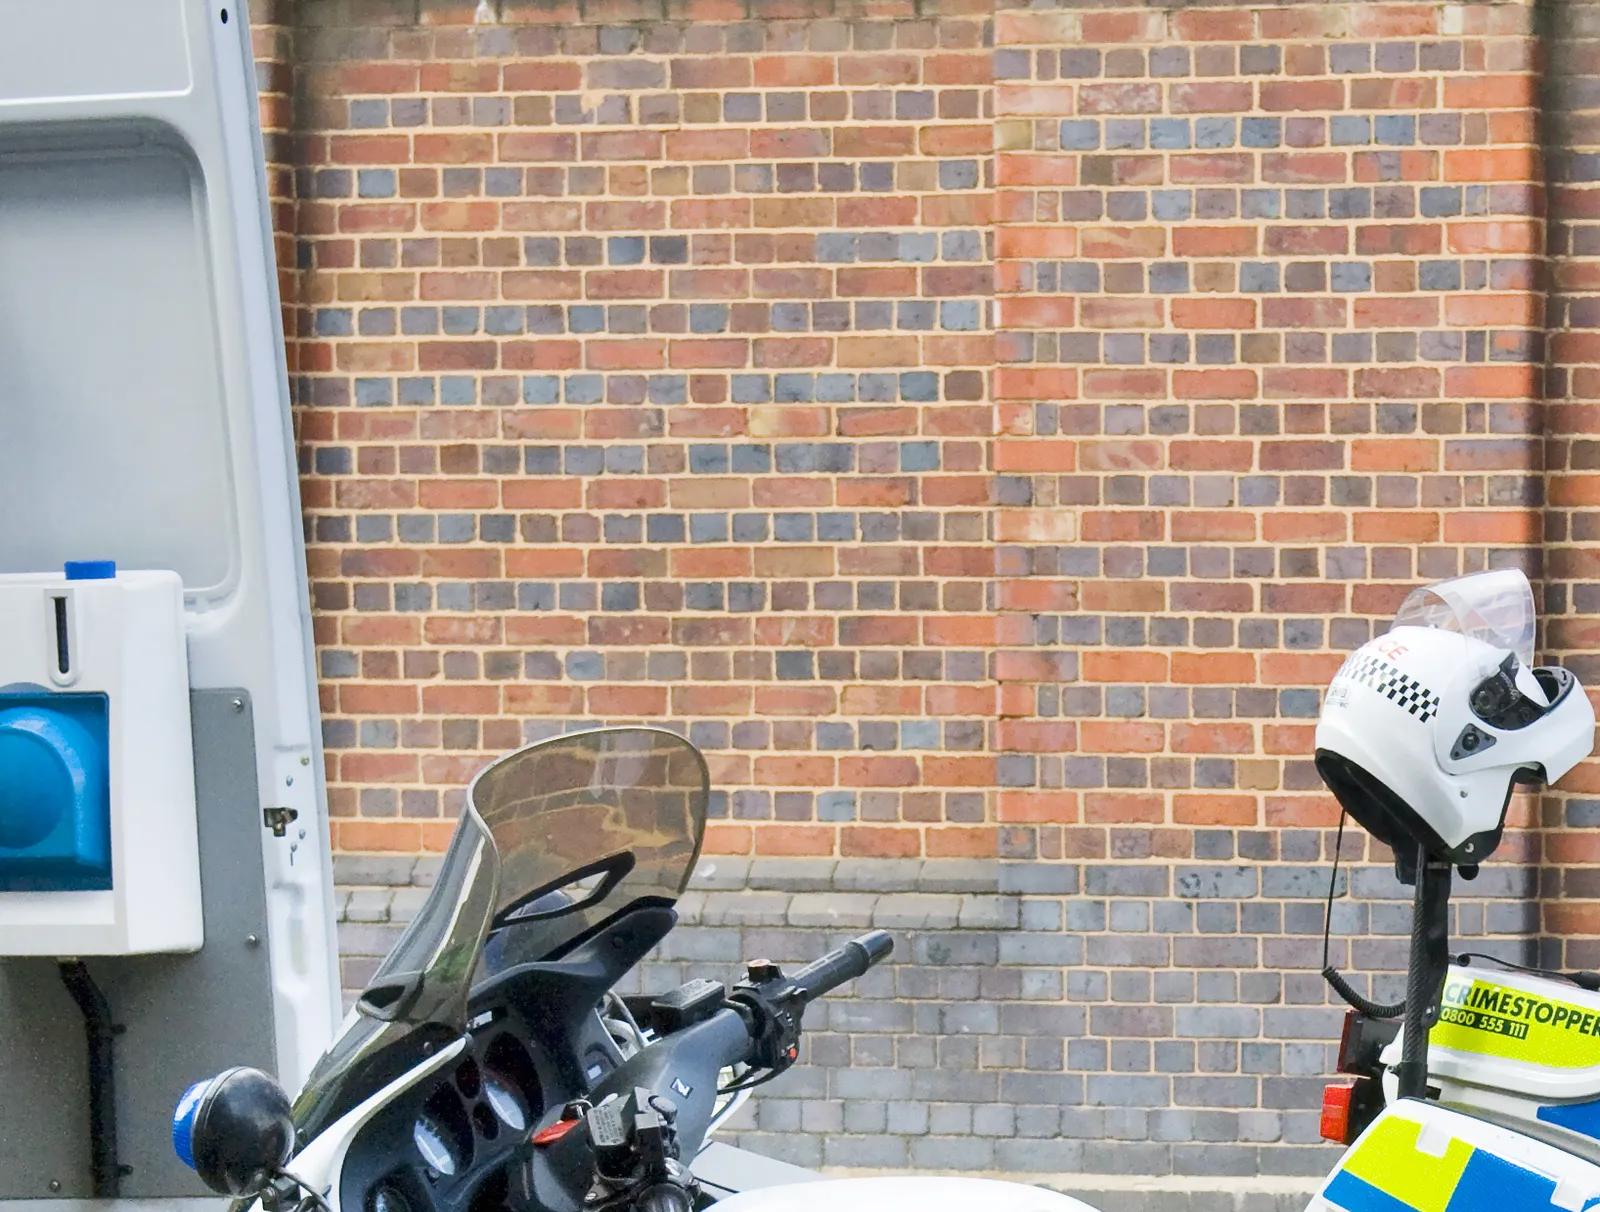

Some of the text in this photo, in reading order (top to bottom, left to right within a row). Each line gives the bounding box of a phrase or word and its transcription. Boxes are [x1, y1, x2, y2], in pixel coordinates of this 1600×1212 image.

[1441, 1007, 1526, 1037] 0800 555 111
